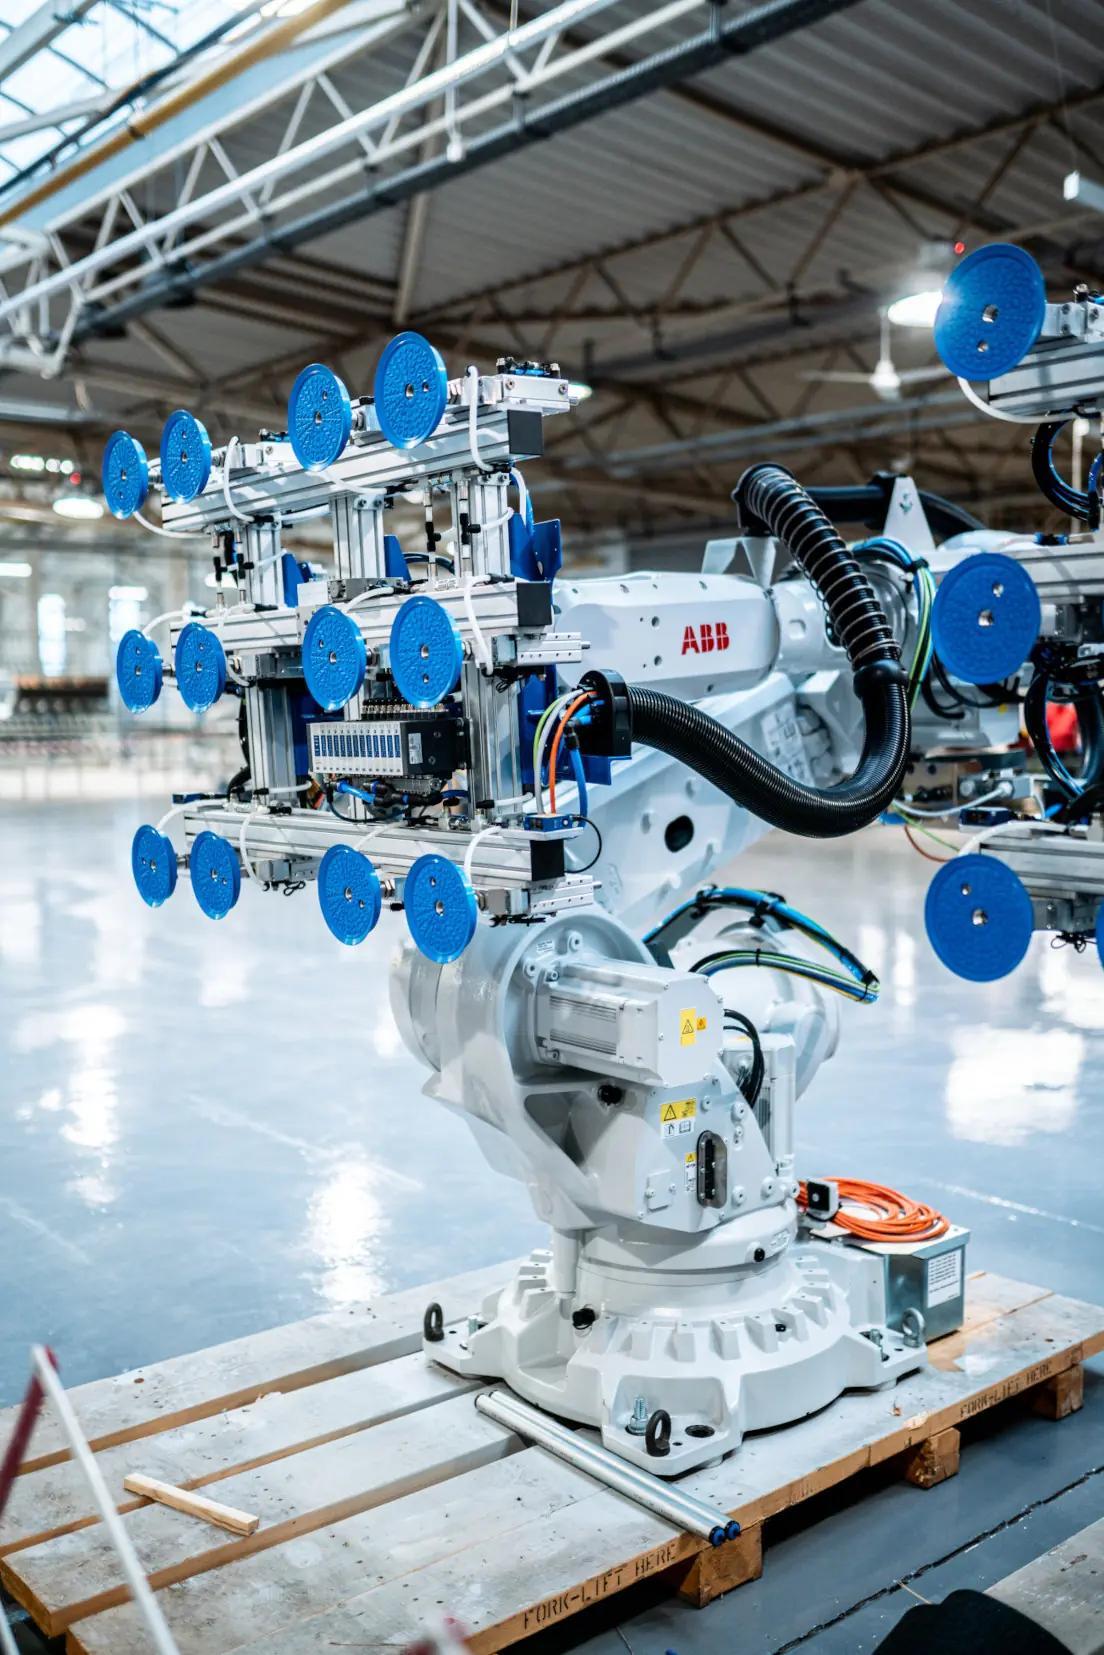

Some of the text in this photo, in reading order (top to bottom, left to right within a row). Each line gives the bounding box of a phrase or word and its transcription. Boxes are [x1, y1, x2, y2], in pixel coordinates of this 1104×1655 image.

[681, 622, 730, 655] ABB
[524, 1543, 676, 1630] FORK-LIFT HERE
